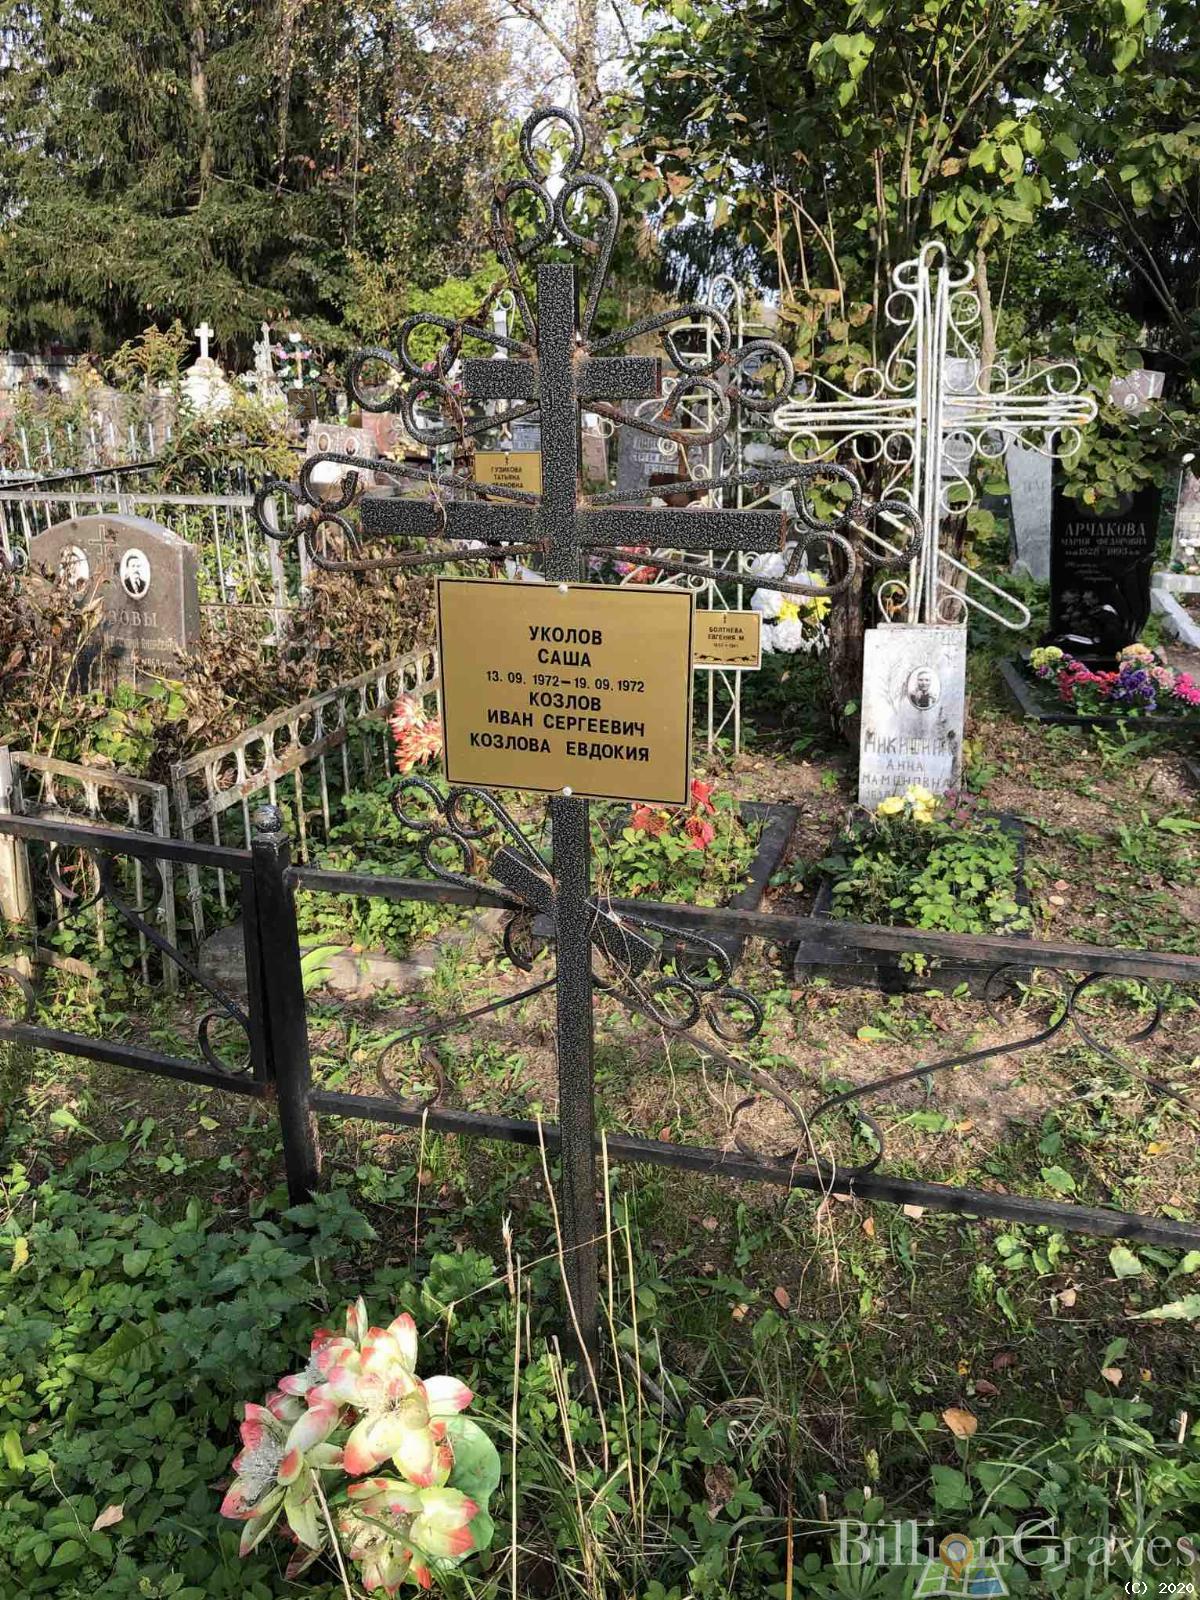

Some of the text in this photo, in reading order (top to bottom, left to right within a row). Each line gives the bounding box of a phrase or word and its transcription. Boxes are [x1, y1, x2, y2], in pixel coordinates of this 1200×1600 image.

[1065, 522, 1146, 537] АРЧАКОВА
[529, 626, 602, 645] УКОЛОВ
[538, 648, 591, 667] САША
[486, 671, 503, 682] 13.
[508, 672, 526, 685] 09.
[595, 678, 614, 692] 09.
[617, 680, 645, 693] 1972
[529, 691, 602, 712] КОЗЛОВ
[488, 709, 645, 737] ИВАН СЕРГЕЕВИЧ
[470, 732, 650, 762] КОЗЛОВА ЕВДОКИЯ
[886, 758, 924, 772] АННА
